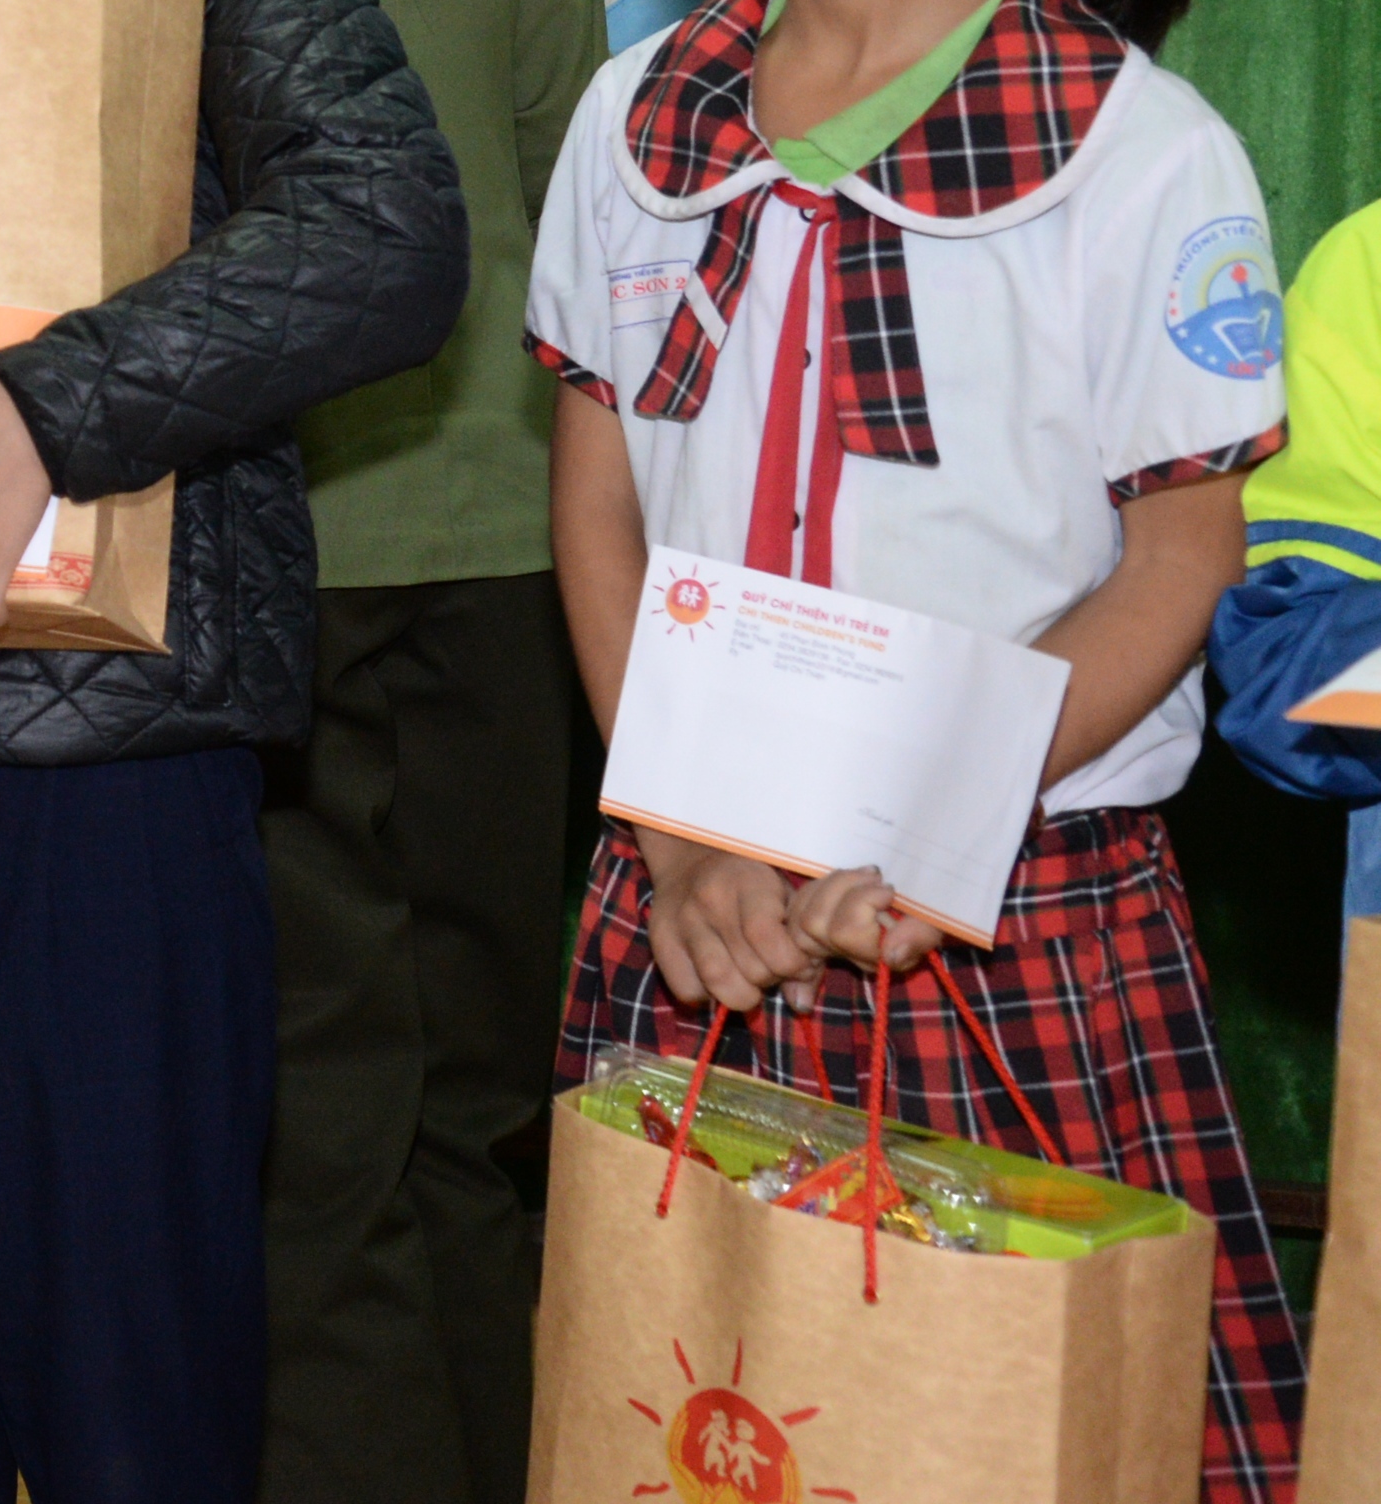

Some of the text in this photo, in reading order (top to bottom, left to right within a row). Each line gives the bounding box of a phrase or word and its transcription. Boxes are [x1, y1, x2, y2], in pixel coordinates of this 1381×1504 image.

[675, 276, 687, 290] 2
[770, 598, 793, 612] CHÍ
[796, 604, 829, 622] THIỆN
